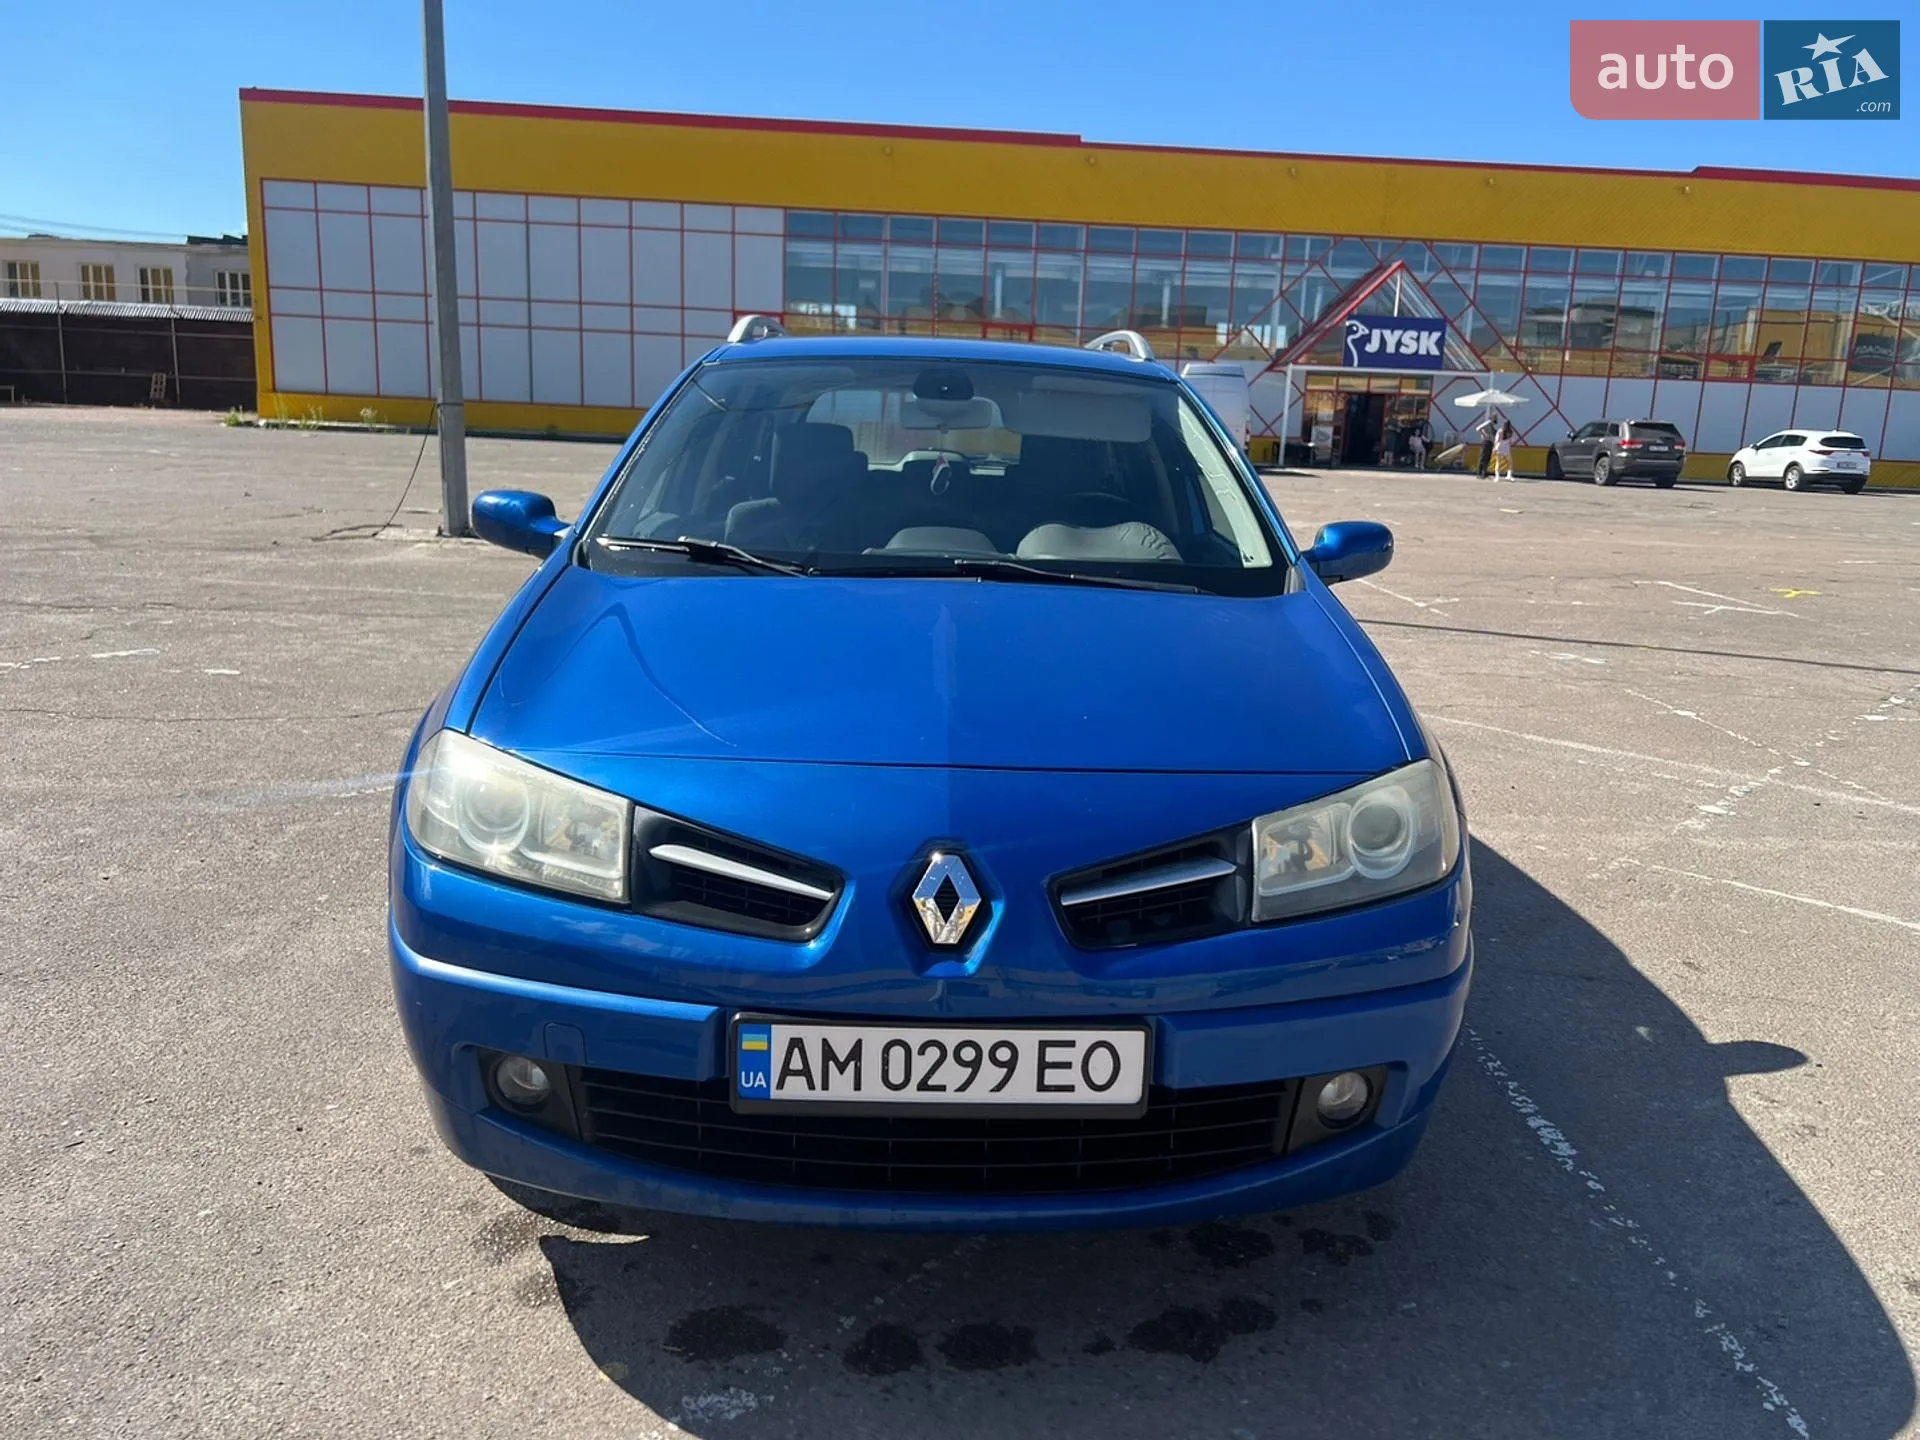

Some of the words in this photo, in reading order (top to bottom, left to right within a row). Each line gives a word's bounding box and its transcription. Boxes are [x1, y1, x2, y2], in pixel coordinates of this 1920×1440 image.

[1365, 329, 1441, 355] JYSK
[775, 1037, 863, 1091] AM
[880, 1039, 1019, 1093] 0299
[1037, 1040, 1121, 1093] EO
[741, 1071, 767, 1088] UA
